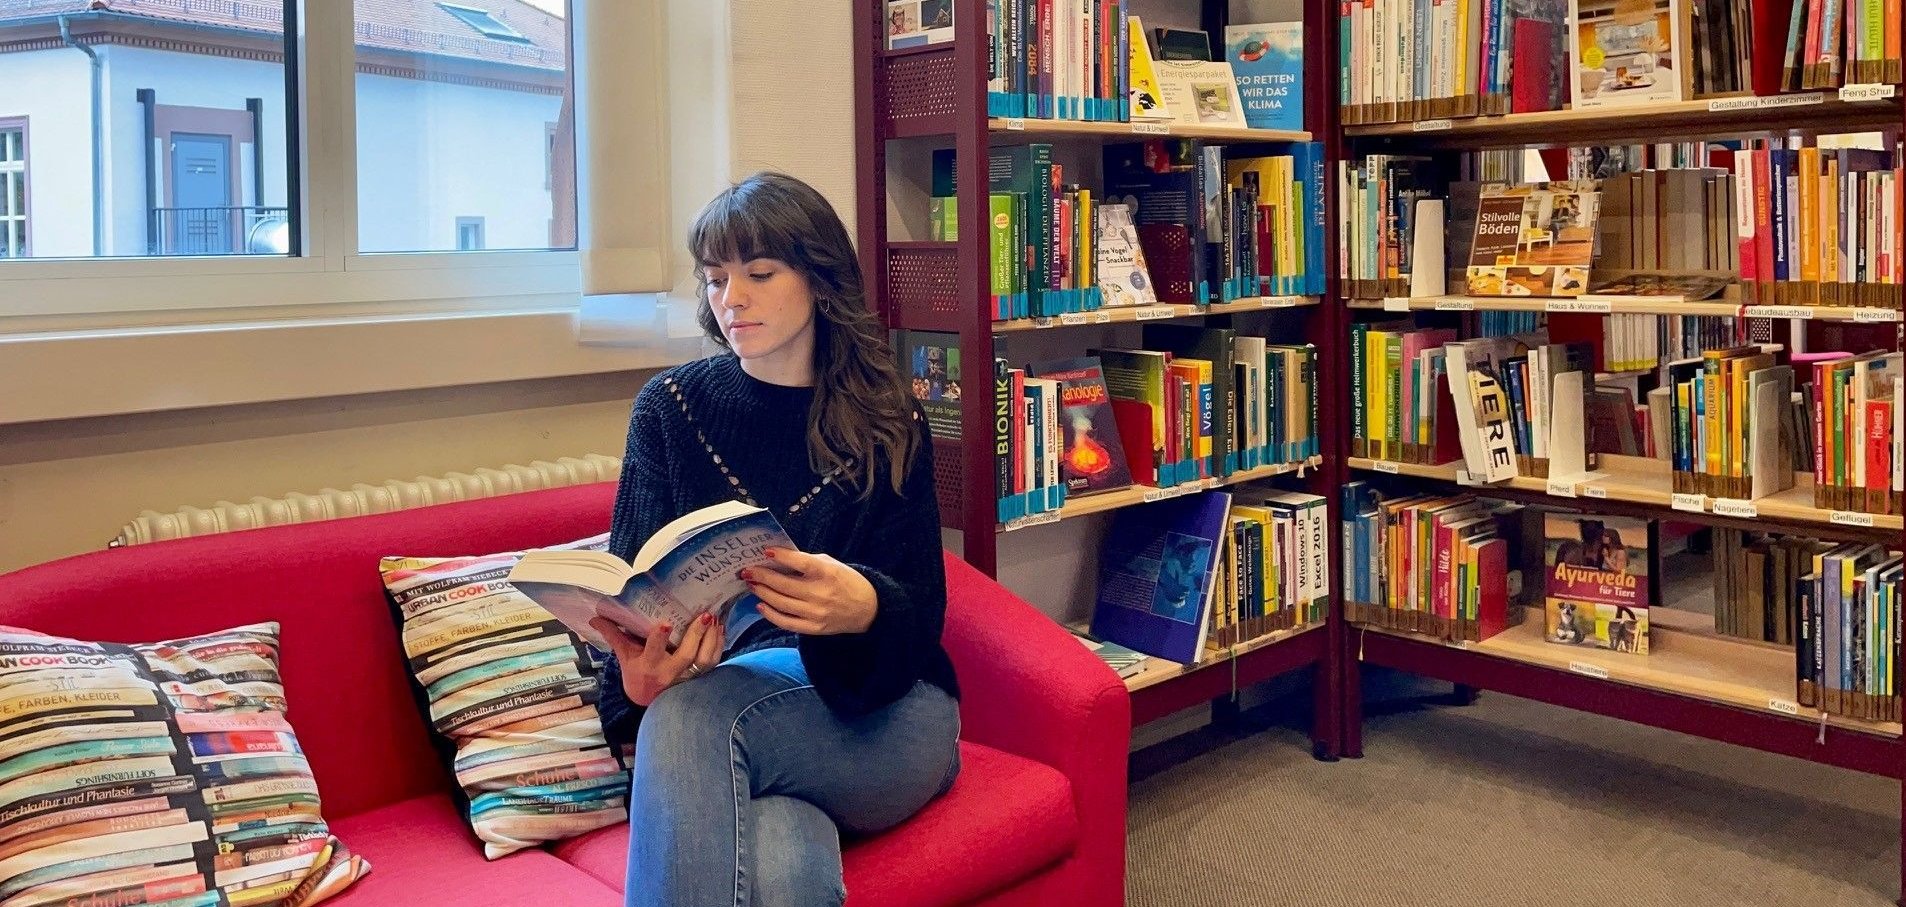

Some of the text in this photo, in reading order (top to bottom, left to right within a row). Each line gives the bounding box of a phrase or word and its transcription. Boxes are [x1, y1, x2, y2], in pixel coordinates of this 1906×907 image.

[1028, 43, 1038, 76] 2084
[1161, 70, 1227, 80] Energiesparpaket
[1236, 74, 1295, 86] SO RETTEN
[1242, 87, 1288, 98] WIR DAS
[1842, 88, 1892, 99] Feng Shui
[1248, 100, 1282, 109] KLIMA
[1711, 95, 1822, 110] Gestaltung Kinderzimmer
[1008, 119, 1023, 128] Klima
[1132, 123, 1146, 132] Natur
[1414, 121, 1450, 130] Gestaltung
[1317, 159, 1325, 225] PLANET
[1481, 213, 1520, 223] Stilvolle
[1478, 223, 1519, 235] Böden
[1042, 237, 1050, 283] PFLANZEN
[1106, 256, 1134, 264] Snackbar
[1436, 302, 1473, 310] Gestaltung
[1548, 302, 1567, 310] Haus
[1855, 311, 1895, 321] Heizung
[1352, 329, 1360, 386] Heimwerkerbuch
[1354, 387, 1362, 407] große
[1708, 378, 1717, 420] AQUARIUM
[1203, 387, 1212, 430] Vögel
[996, 378, 1009, 456] BIONIK
[1376, 462, 1398, 472] Bauen
[1549, 484, 1571, 494] Pferd
[1585, 487, 1605, 496] Tiere
[1145, 493, 1159, 501] Natur
[1672, 494, 1700, 506] Fische
[1713, 503, 1756, 515] Nagetiere
[679, 533, 775, 582] DIE INSEL DER
[1297, 519, 1306, 589] Windows 10
[1312, 516, 1321, 590] Excel 2016
[1437, 549, 1450, 574] Hilde
[1554, 562, 1636, 588] Ayurveda
[405, 586, 424, 598] MIT
[426, 575, 468, 592] WOLFRAM
[1599, 585, 1636, 598] für Tiere
[406, 582, 514, 613] URBAN COOK BOO
[412, 612, 532, 651] STOFFE, FARBEN, KLEIDER
[0, 643, 92, 655] OLFRAM SIEBECK
[20, 656, 65, 667] COOK
[66, 655, 114, 667] BOOK
[1571, 663, 1608, 677] Haustiere
[20, 691, 121, 709] FARBEN, KLEIDER
[1770, 701, 1796, 712] Katze
[451, 689, 554, 726] Tischkultur und Phantasie
[75, 769, 156, 786] SOFT FURNISHINGS
[516, 767, 575, 787] Schuhe
[0, 785, 135, 821] Tischkultur und Phantasie
